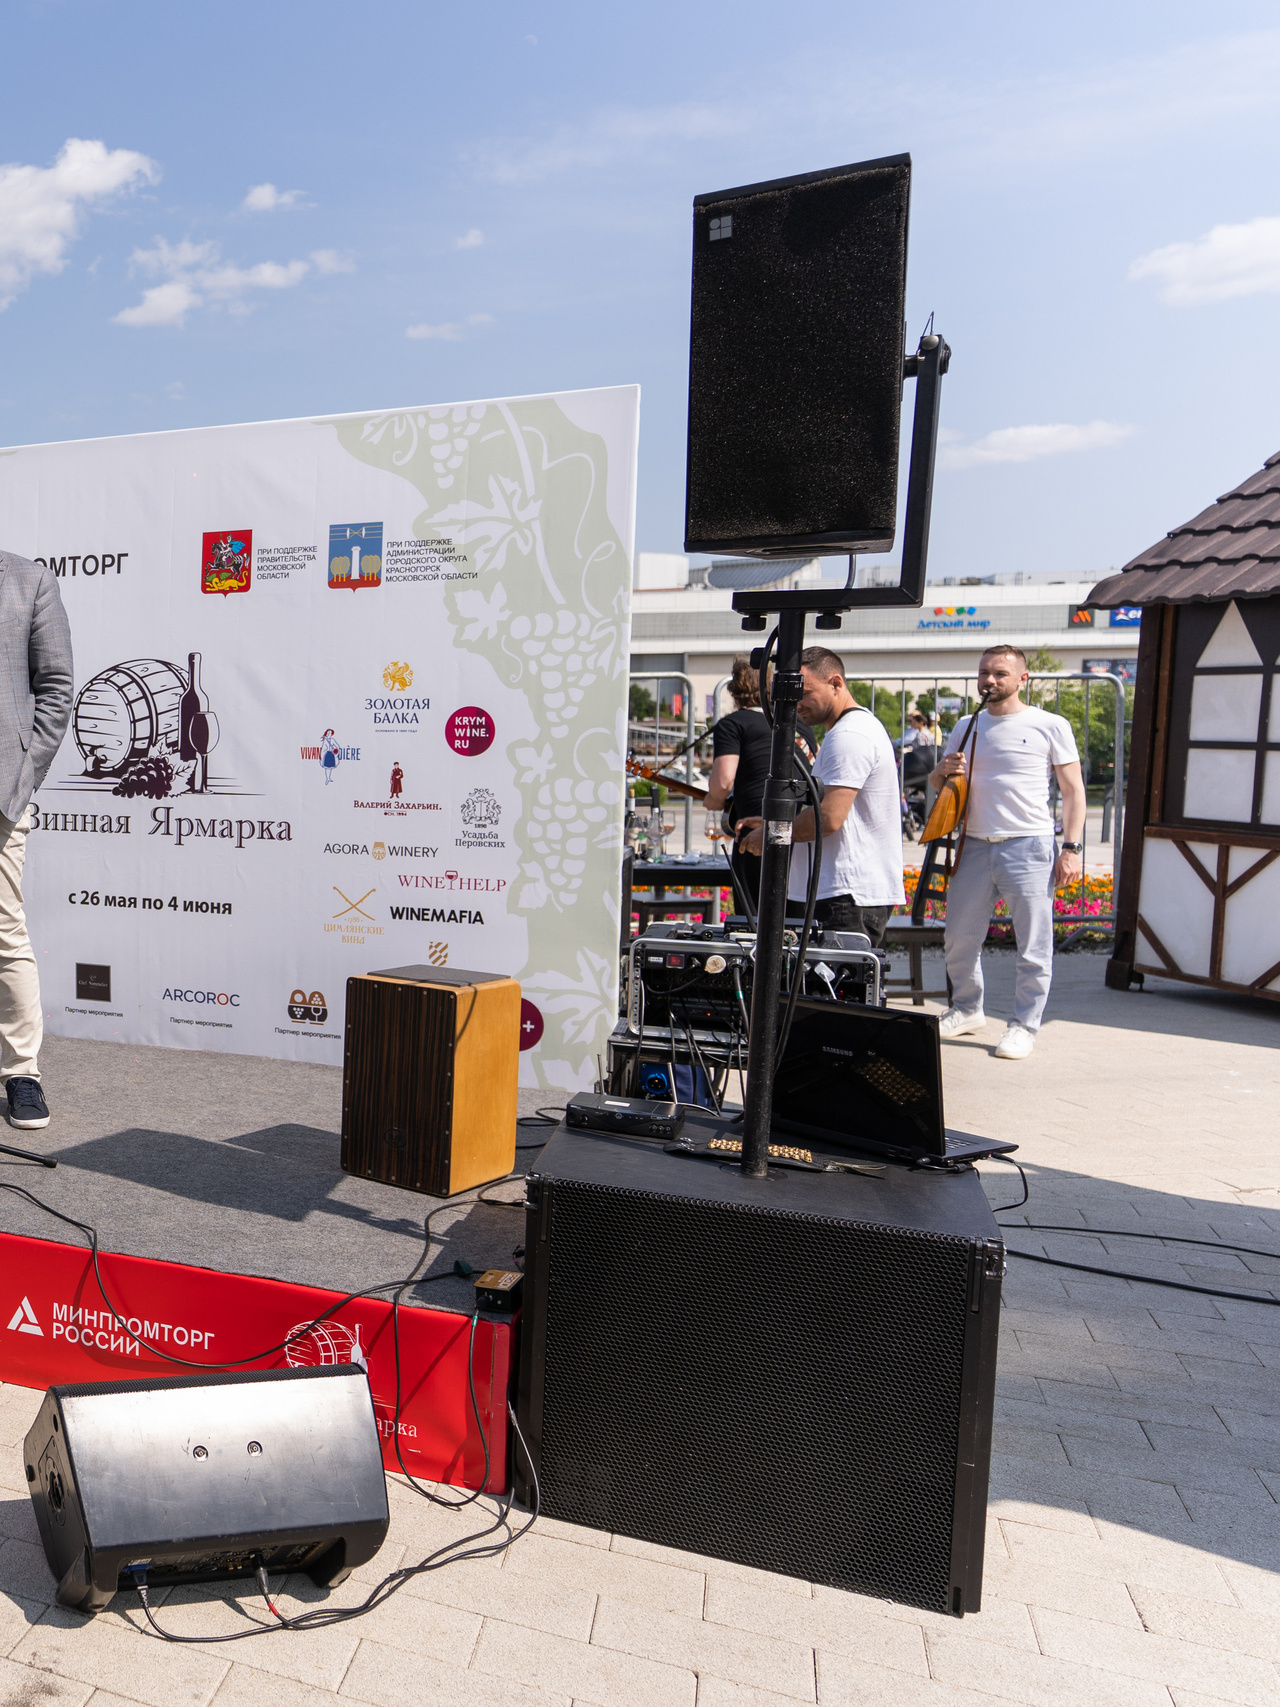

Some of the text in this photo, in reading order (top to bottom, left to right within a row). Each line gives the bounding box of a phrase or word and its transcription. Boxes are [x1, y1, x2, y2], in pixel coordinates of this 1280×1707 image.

[404, 538, 452, 548] ПОДДЕРЖКЕ
[273, 546, 318, 555] ПОДДЕРЖКЕ
[386, 547, 456, 557] АДМИНИСТРАЦИИ
[257, 554, 316, 563] ПРАВИТЕЛЬСТВА
[386, 555, 468, 566] ГОРОДСКОГО ОКРУГА
[34, 553, 128, 577] МТОРГ
[257, 562, 306, 572] МОСКОВСКОЙ
[386, 565, 441, 574] КРАСНОГОРСК
[256, 572, 290, 580] ОБЛАСТИ
[386, 572, 478, 582] МОСКОВСКОЙ ОБЛАСТИ
[364, 698, 430, 710] ЗОЛОТАЯ
[374, 712, 419, 724] БАЛКА
[455, 716, 486, 725] KRYM
[454, 726, 490, 737] WINE.
[454, 740, 470, 748] RU
[148, 806, 293, 848] Ярмарка
[462, 830, 498, 840] Усадьба
[455, 838, 506, 848] Перовских
[324, 843, 439, 858] AGORA WINERY
[68, 890, 232, 914] с 26 мая по 4 июня
[390, 906, 484, 925] WINEMAFIA
[324, 923, 384, 935] ЦИМЛЯНСКИЕ
[342, 935, 365, 944] ВИНА
[162, 988, 240, 1007] ARCOROC
[65, 1006, 124, 1018] Партнер мероприятия
[170, 1017, 233, 1029] Партнер мероприятия
[274, 1027, 342, 1040] Партнер мероприятия
[53, 1302, 215, 1350] МИНПРОМТОРГ
[52, 1322, 140, 1356] РОССИИ
